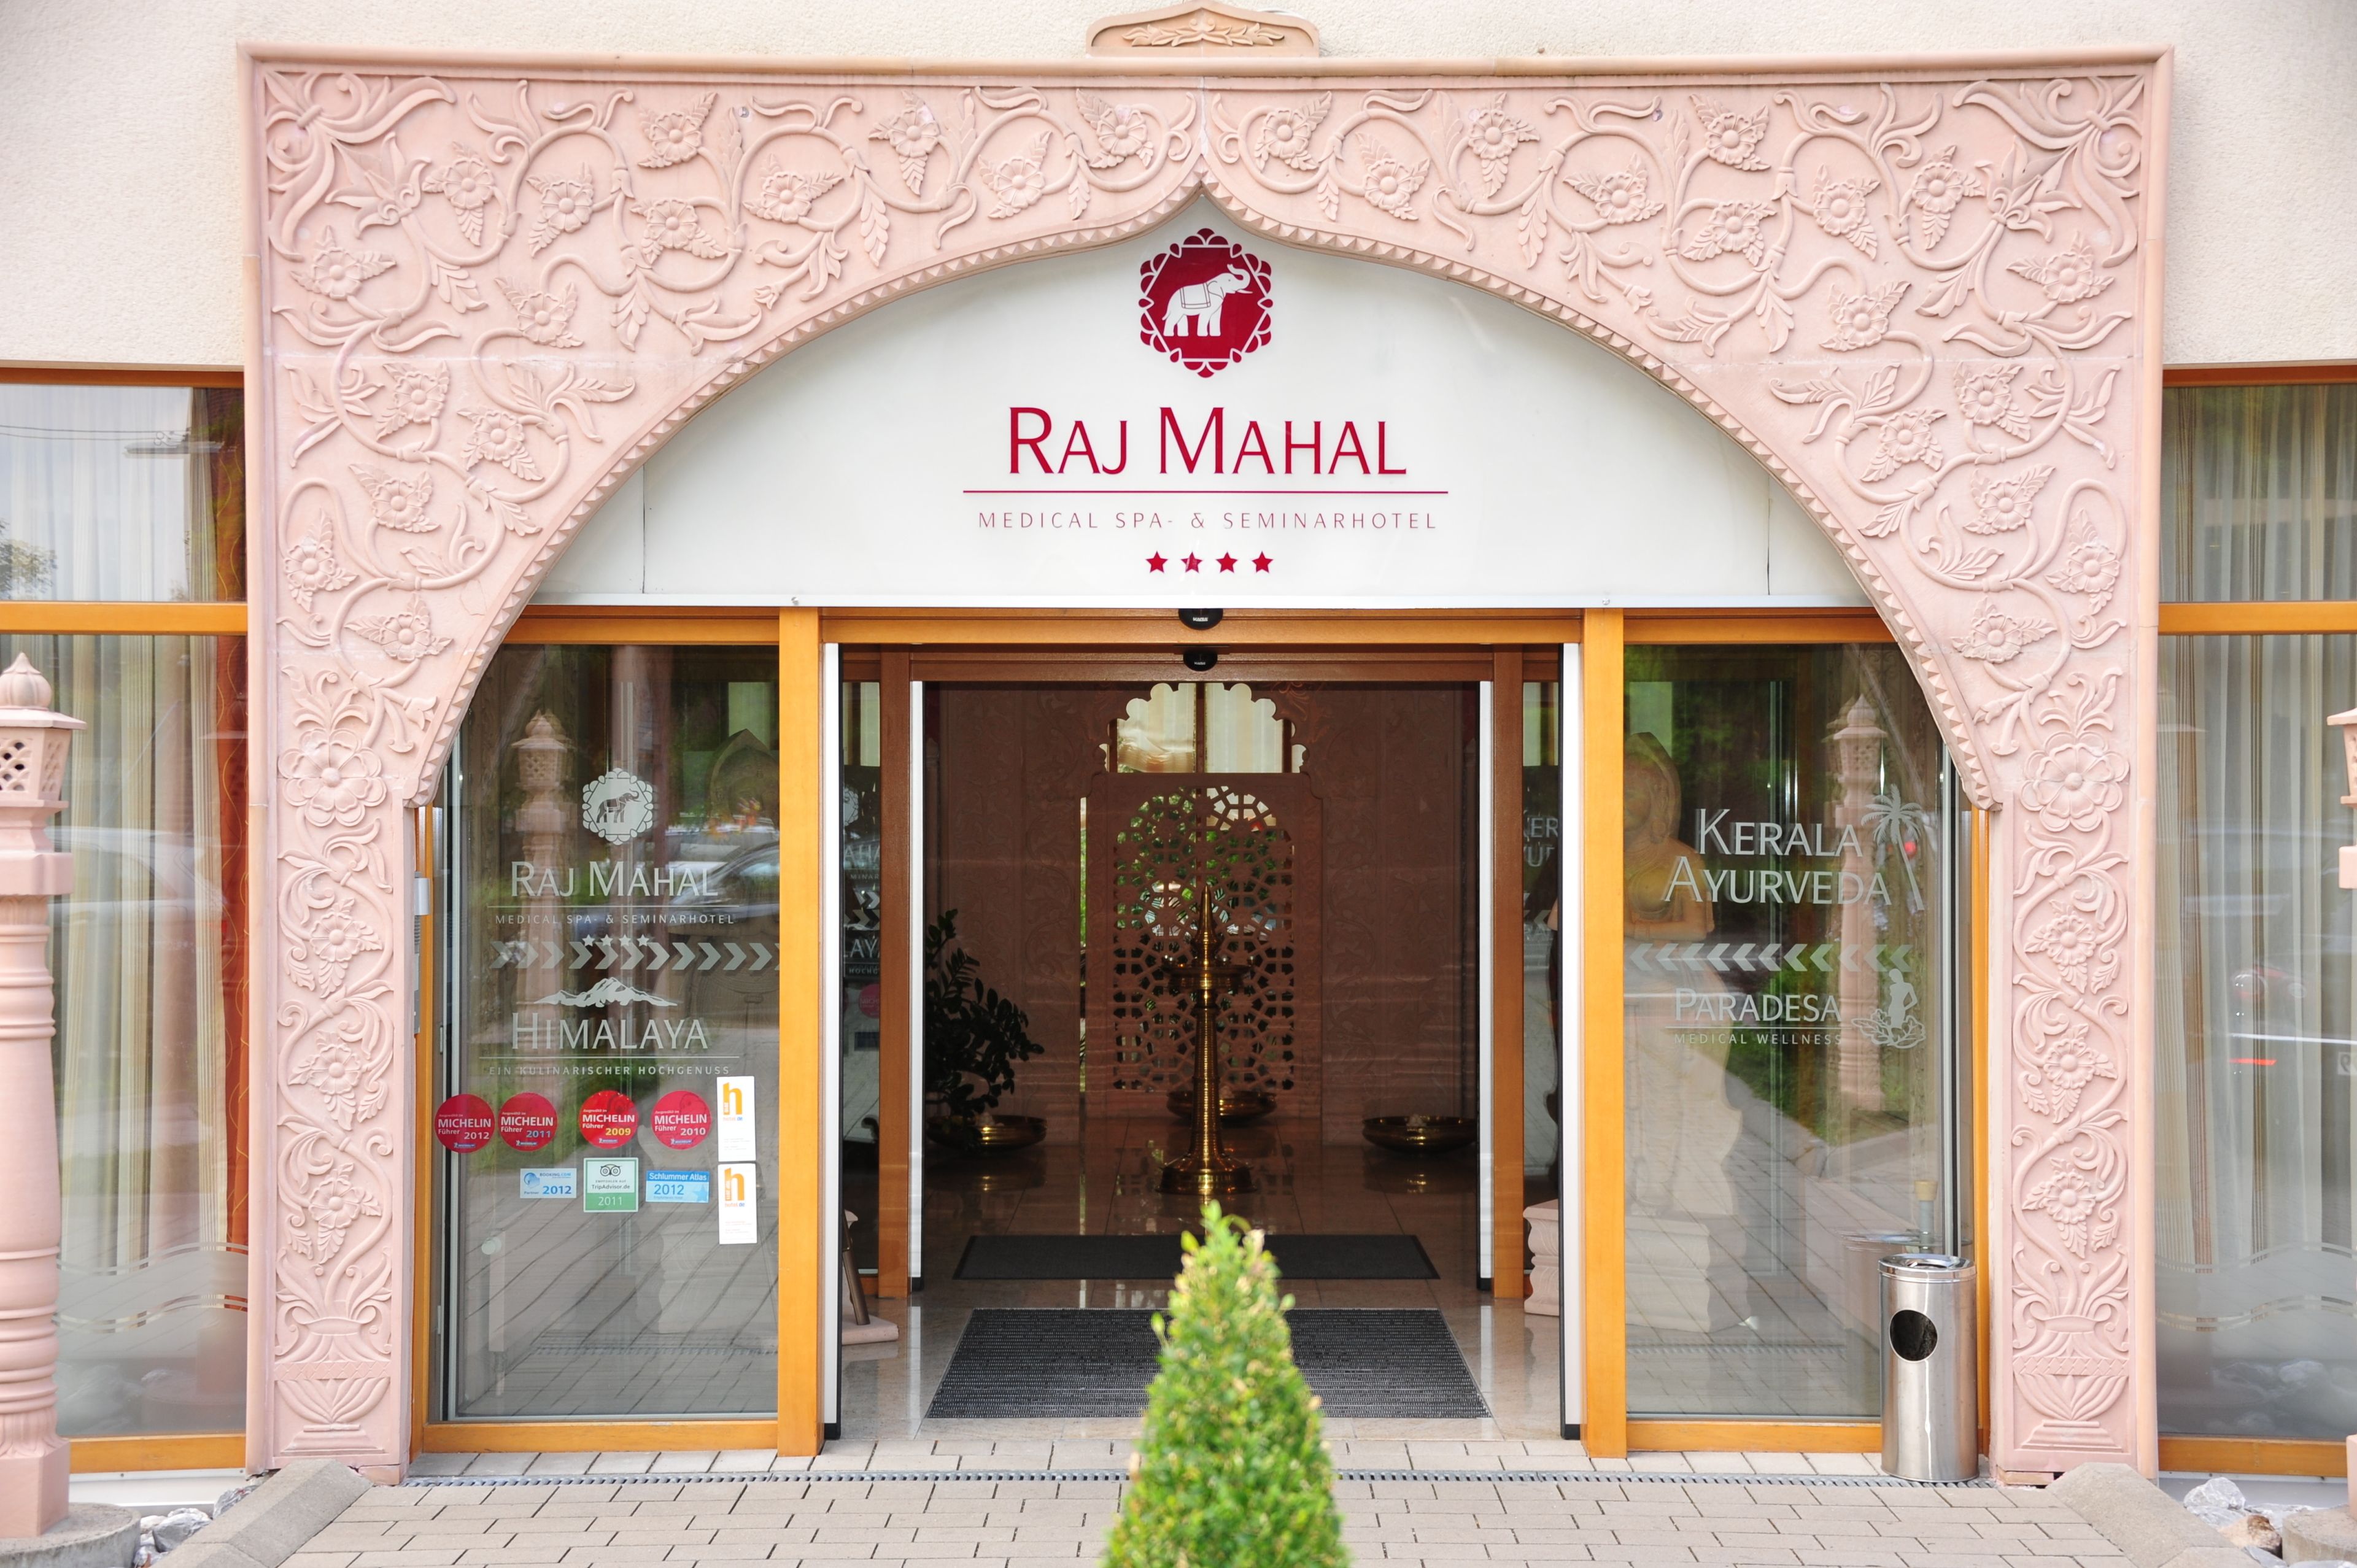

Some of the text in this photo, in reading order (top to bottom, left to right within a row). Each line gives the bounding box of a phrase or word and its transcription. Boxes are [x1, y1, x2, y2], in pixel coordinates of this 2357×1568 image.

[1008, 407, 1407, 476] RAJ MAHAL
[978, 512, 1436, 529] MEDICAL SPA- & SEMINARHOTEL
[1698, 808, 1864, 857] KERALA
[511, 861, 719, 897] RAJ MAHAL
[1664, 856, 1892, 906] AYURVEDA
[495, 914, 559, 924] MEDICAL
[606, 914, 614, 924] &
[622, 914, 734, 924] SEMINARHOTEL
[1676, 988, 1842, 1022] PARADESA
[512, 1013, 708, 1049] HIMALAYA
[1674, 1033, 1841, 1045] MEDICAL WELLNESS
[489, 1066, 730, 1076] EIN KULINARISCHER HOCHGENUSS
[438, 1119, 491, 1128] MICHELIN
[501, 1116, 553, 1126] MICHELIN
[582, 1114, 635, 1122] MICHELIN
[654, 1114, 706, 1124] MICHELIN
[542, 1186, 571, 1194] 2012
[654, 1184, 684, 1195] 2012
[598, 1197, 622, 1206] 2011
